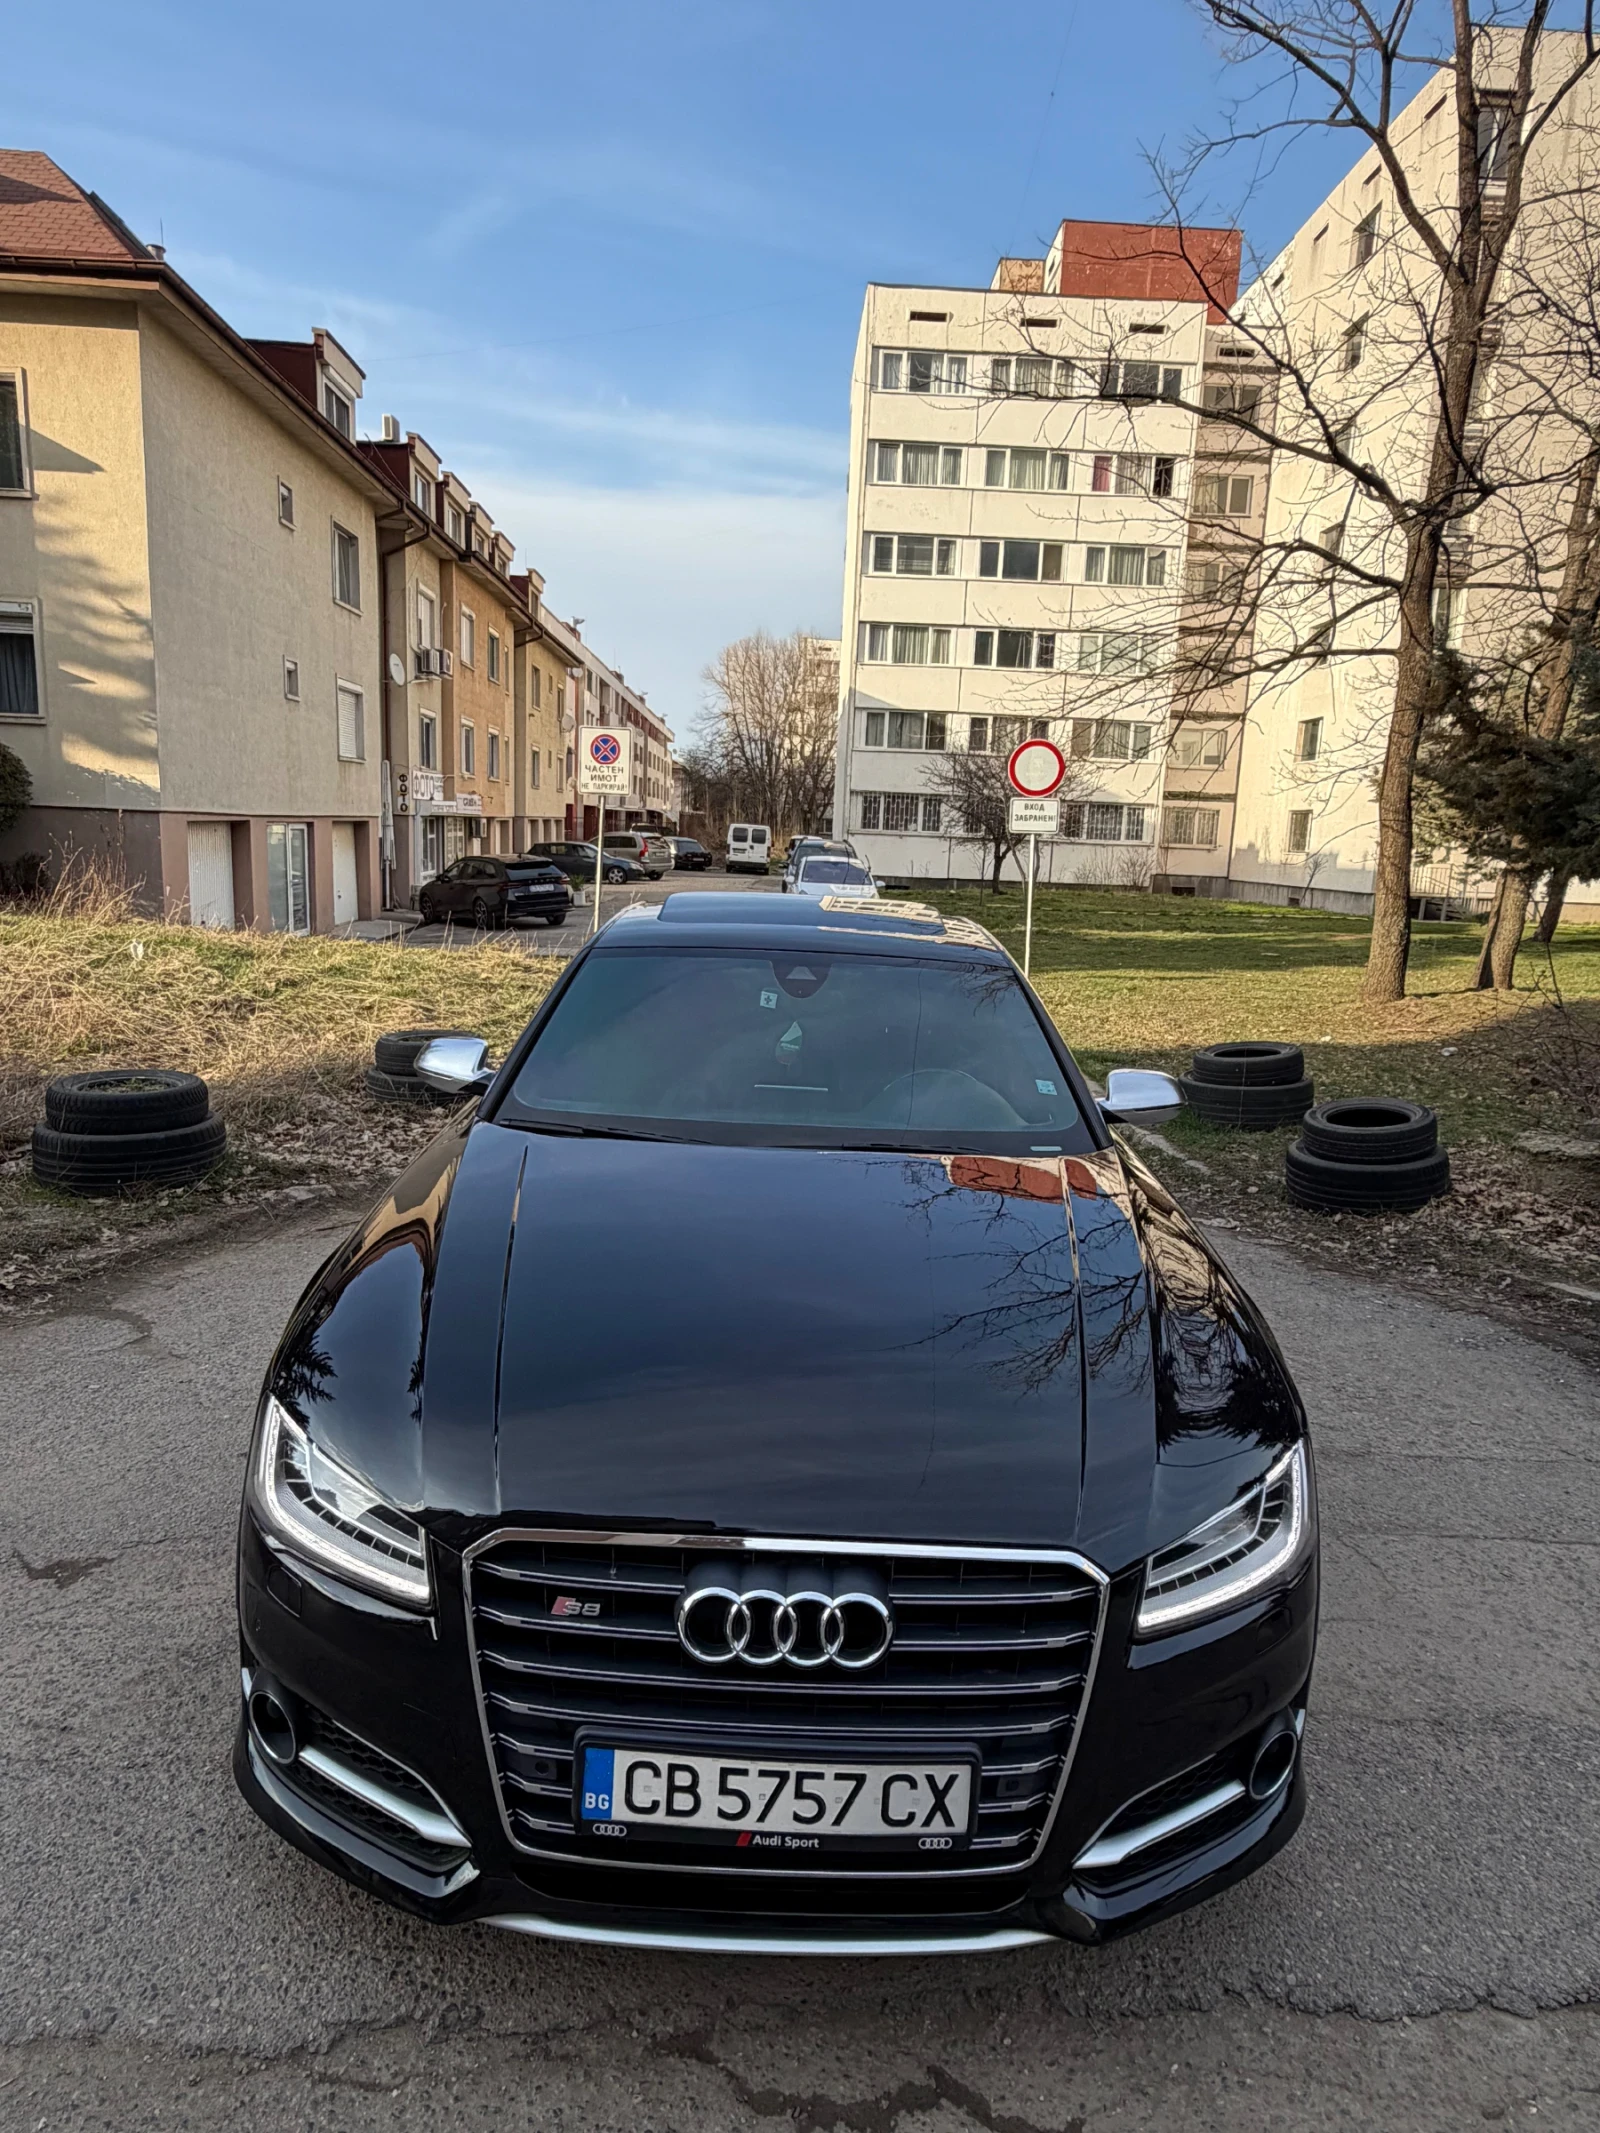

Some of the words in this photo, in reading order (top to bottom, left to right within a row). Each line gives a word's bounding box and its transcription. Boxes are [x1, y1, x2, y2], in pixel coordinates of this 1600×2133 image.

[585, 765, 624, 774] ЧАСТЕН
[591, 774, 618, 782] ИМОТ
[399, 773, 408, 813] ФОТО
[414, 773, 434, 800] ФОТО
[1024, 803, 1045, 812] ВХОД
[563, 1601, 601, 1617] S8
[584, 1792, 610, 1810] BG
[624, 1760, 701, 1818] CB
[717, 1766, 867, 1827] 5757
[881, 1773, 960, 1828] CX
[752, 1834, 781, 1846] Audi
[784, 1836, 819, 1849] Sport
